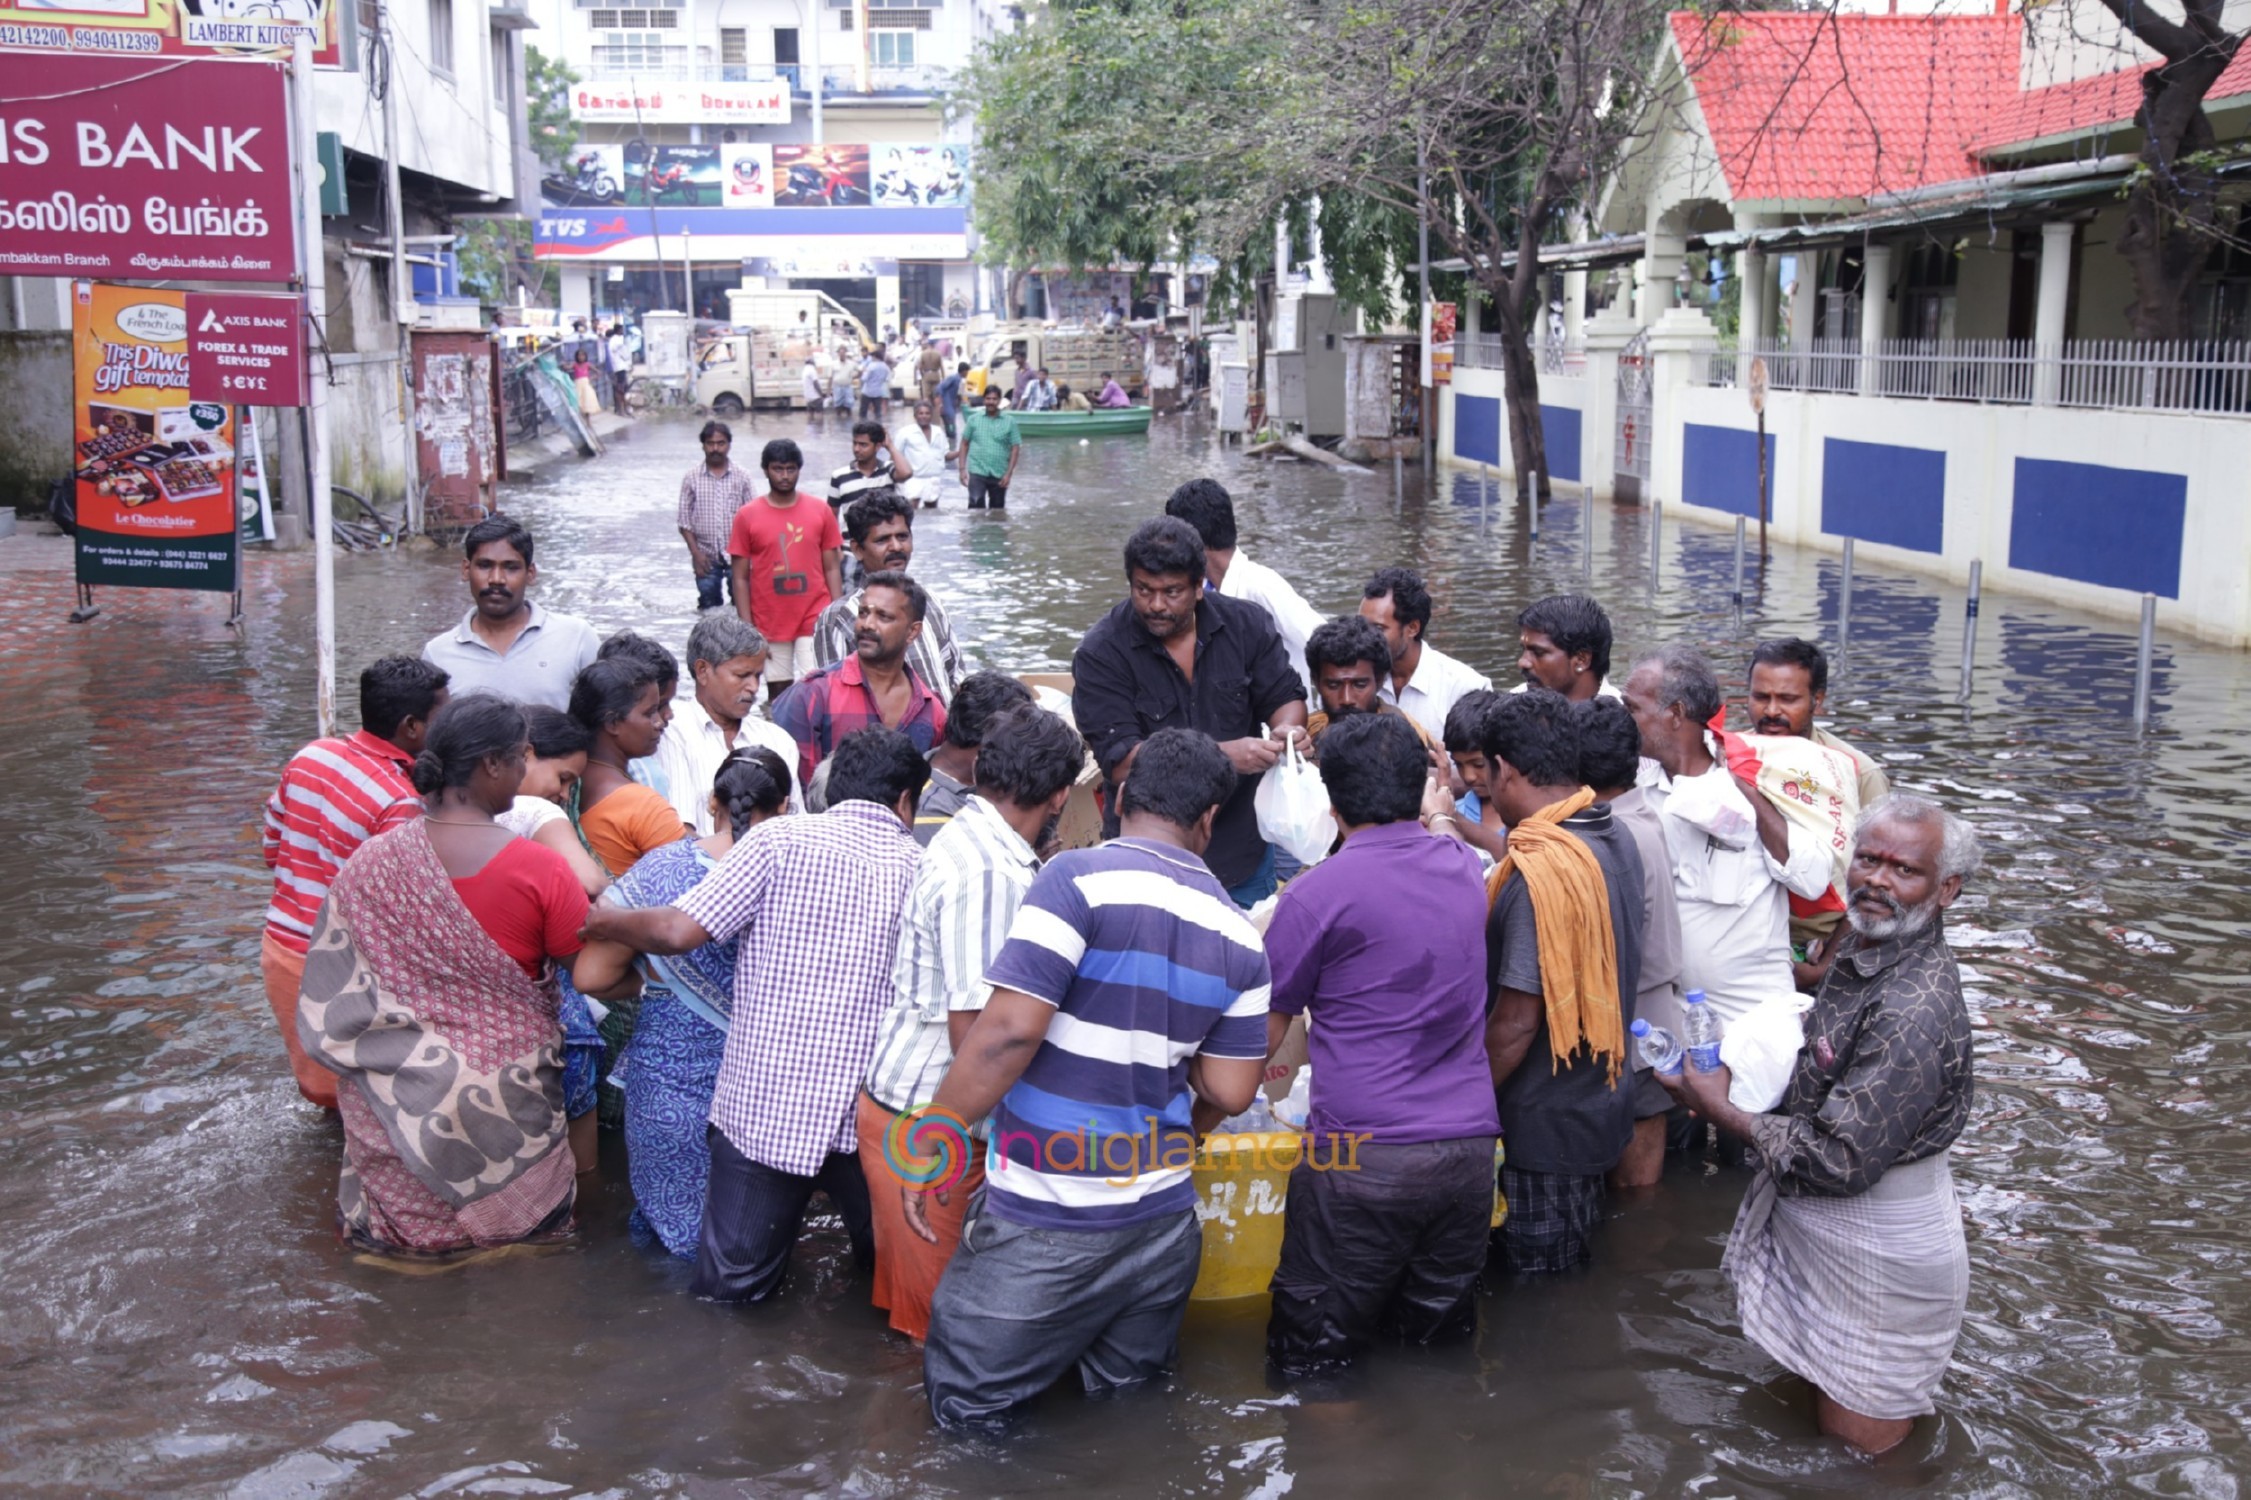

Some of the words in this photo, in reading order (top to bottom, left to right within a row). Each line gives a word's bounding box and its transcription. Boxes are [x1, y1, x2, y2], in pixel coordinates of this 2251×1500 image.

[75, 30, 160, 50] 9940412399
[189, 22, 253, 43] LAMBERT
[0, 118, 49, 166] IS
[76, 121, 264, 173] BANK
[144, 196, 269, 237] பேங்க்
[539, 218, 587, 237] TVS
[0, 252, 62, 265] mbakkam
[64, 254, 111, 267] Branch
[165, 321, 187, 333] Loa
[223, 316, 251, 327] AXIS
[253, 317, 288, 328] BANK
[103, 342, 135, 363] This
[133, 344, 190, 372] Diwa
[197, 341, 236, 353] FOREX
[238, 343, 248, 354] &
[251, 344, 289, 356] TRADE
[217, 355, 271, 368] SERVICES
[94, 360, 132, 392] gift
[133, 369, 190, 388] temptat
[115, 512, 130, 524] Le
[131, 513, 196, 527] Chocolatier
